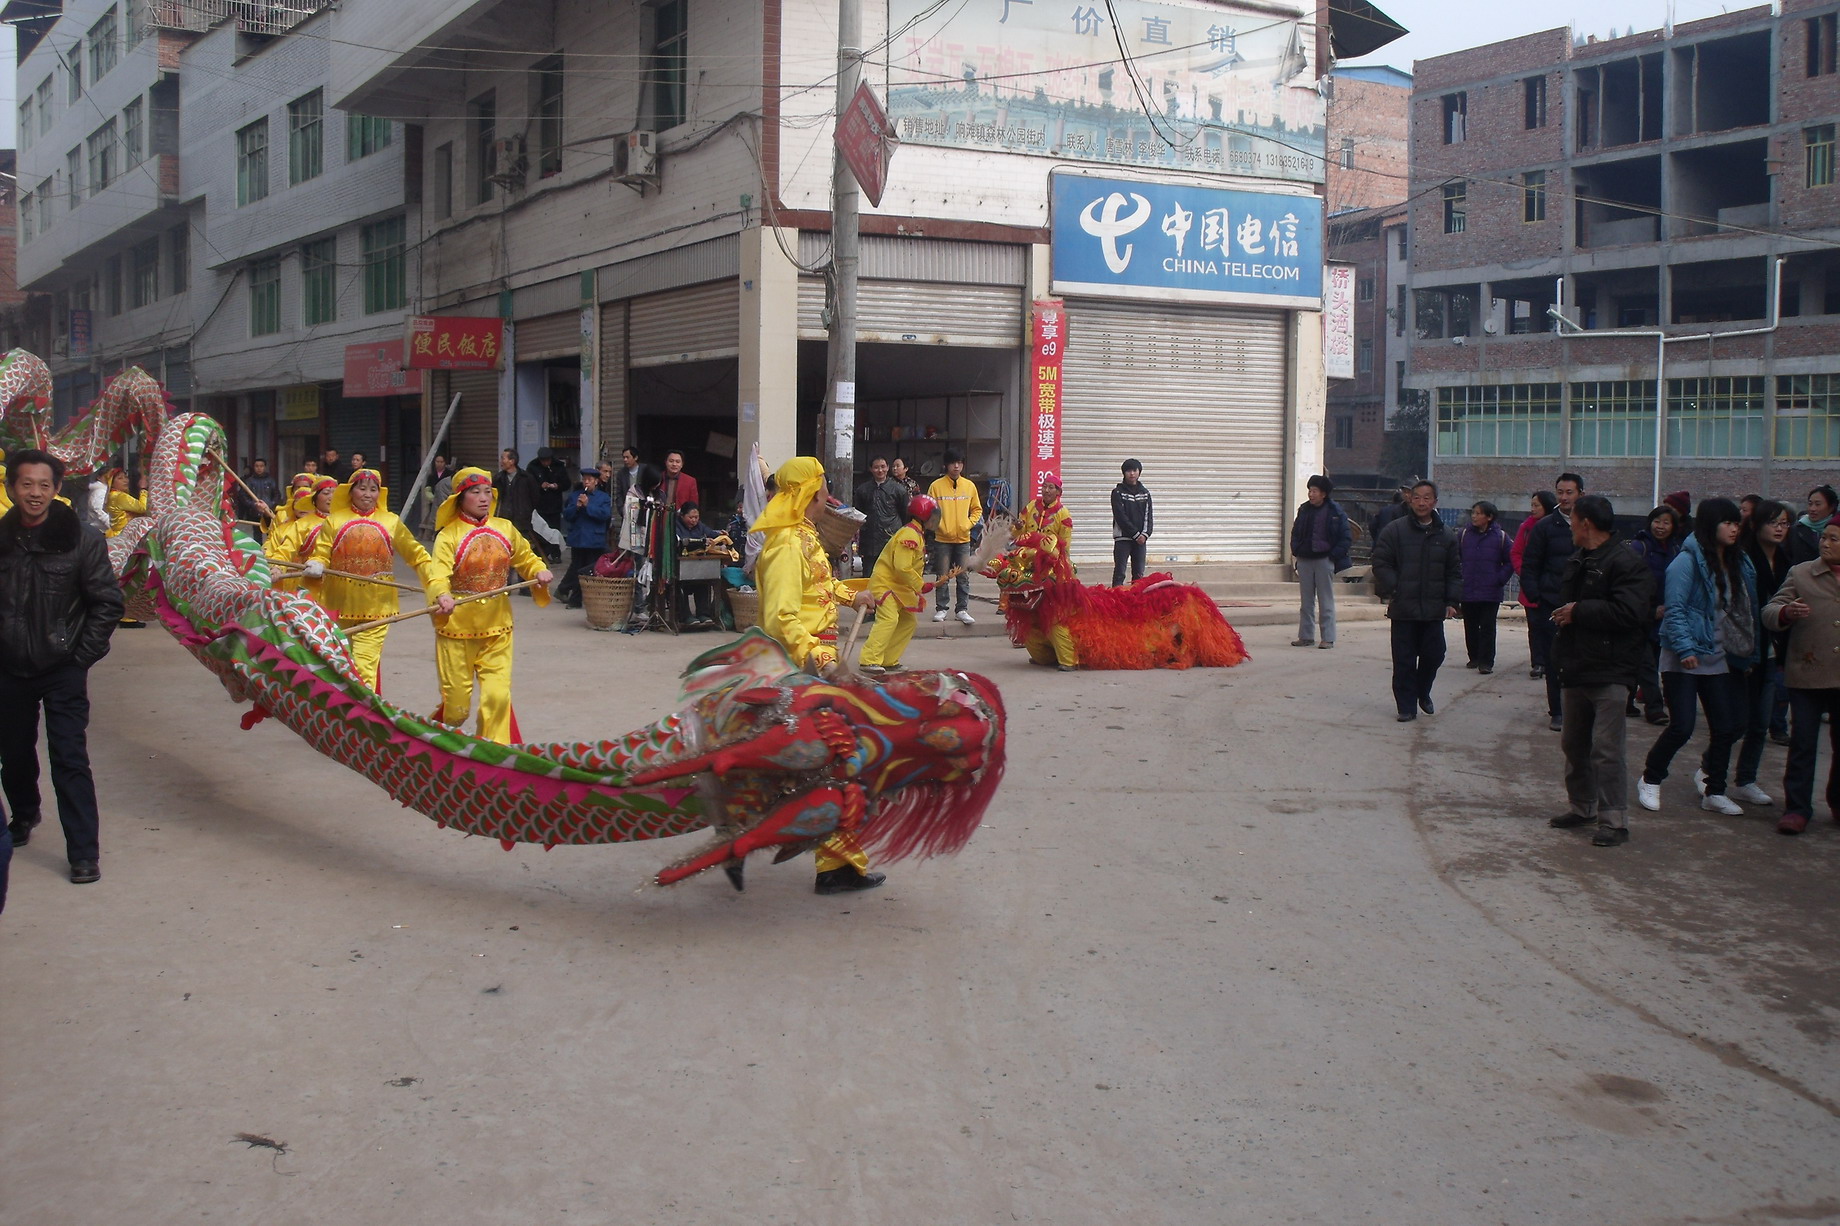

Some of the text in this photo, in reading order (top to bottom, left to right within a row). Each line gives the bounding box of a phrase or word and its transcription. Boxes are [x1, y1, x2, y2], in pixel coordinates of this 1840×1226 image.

[1162, 200, 1300, 258] 中国电信
[1162, 257, 1299, 281] CHINA TELECOM
[415, 332, 496, 358] 便民饭店
